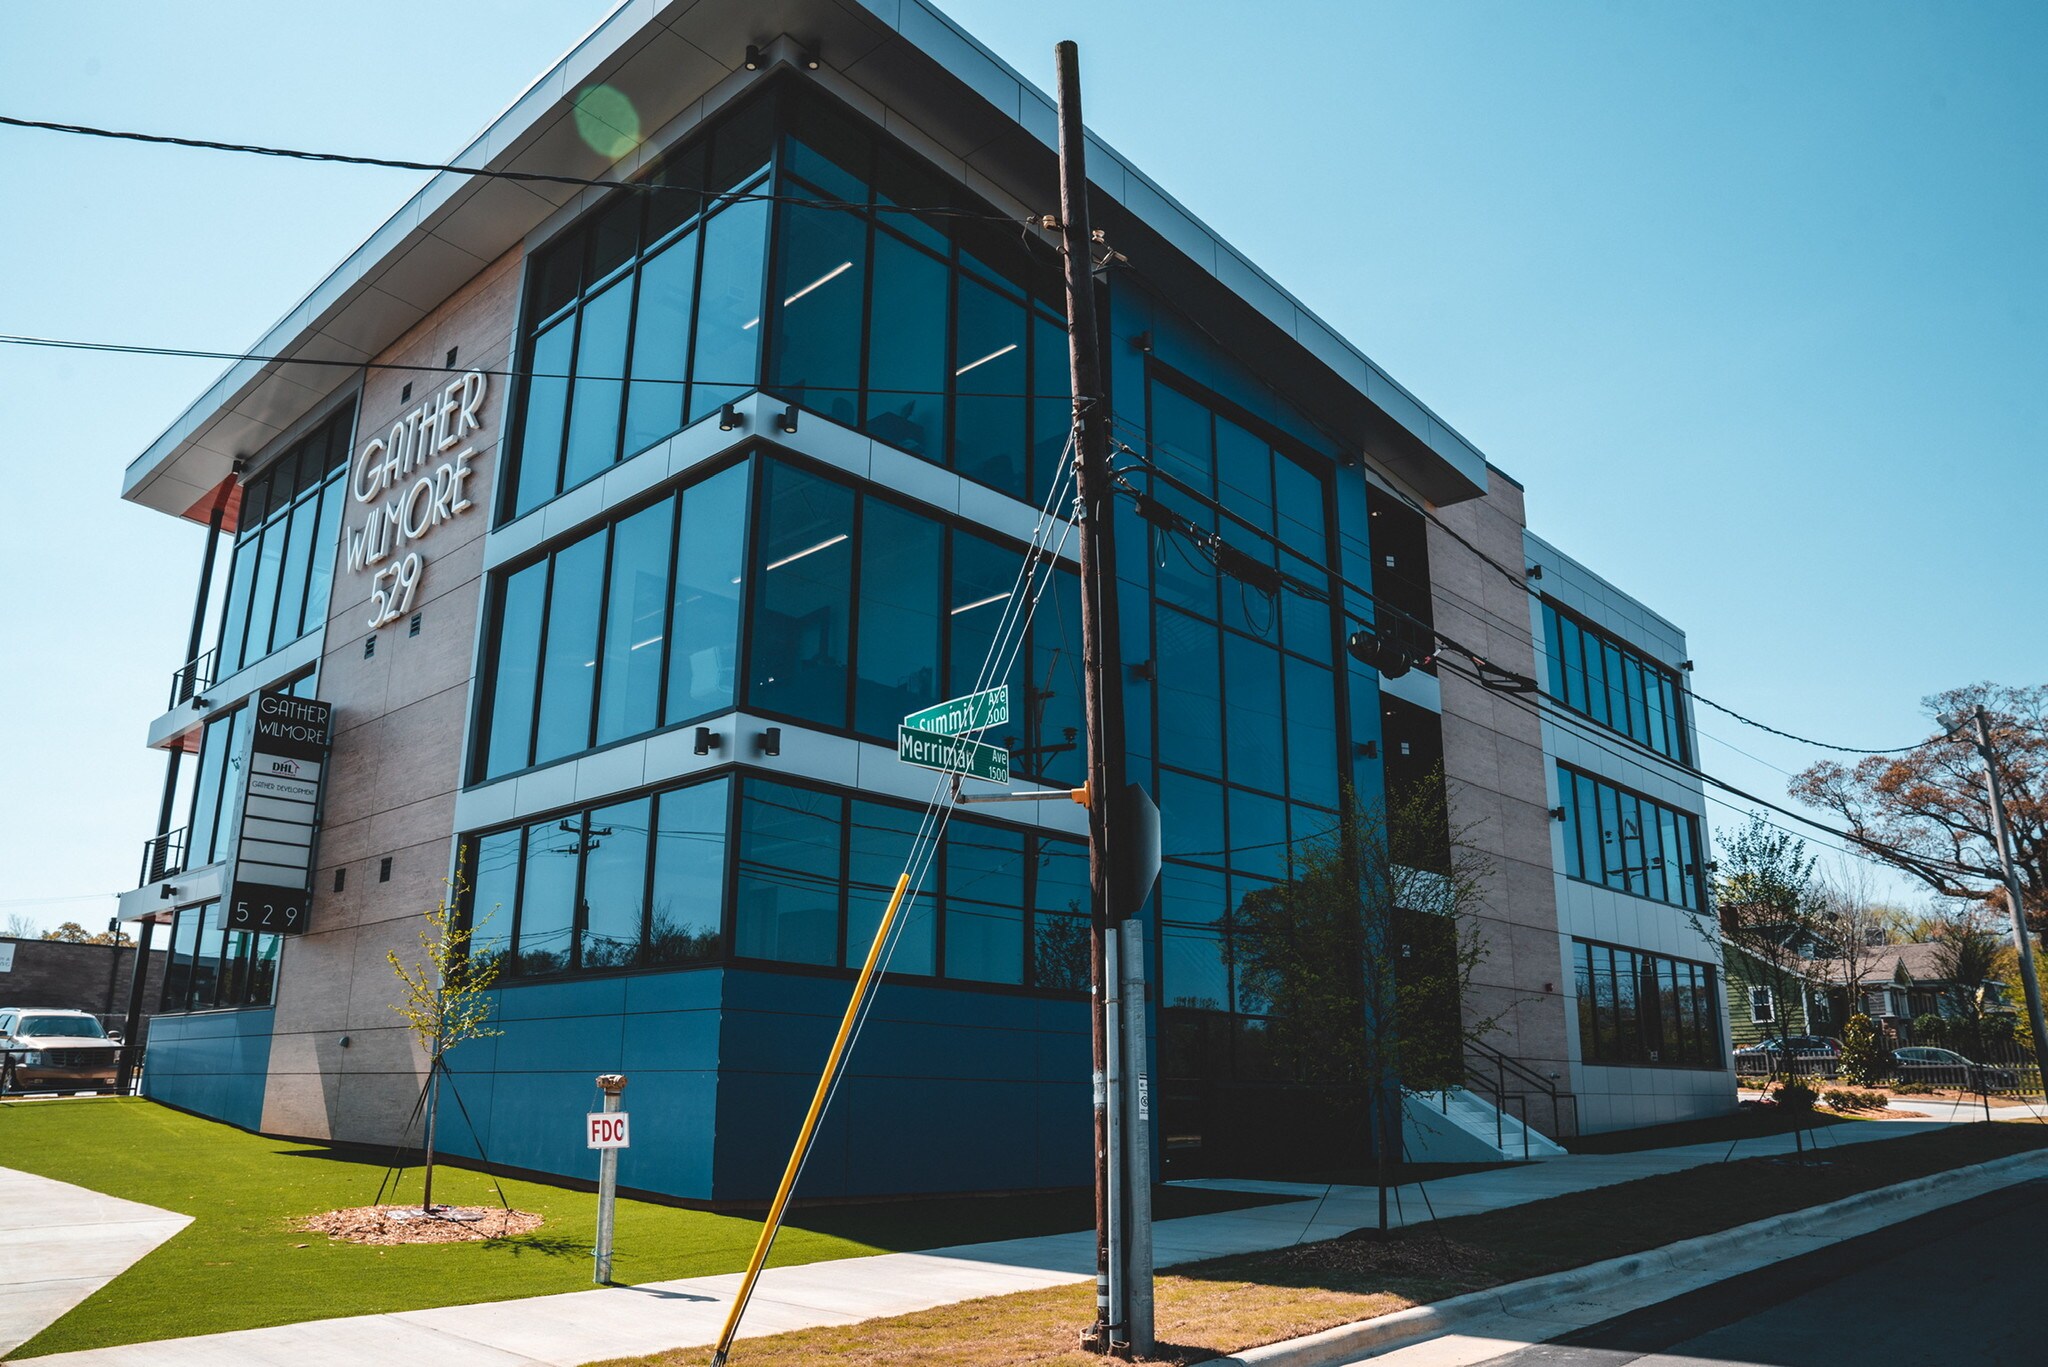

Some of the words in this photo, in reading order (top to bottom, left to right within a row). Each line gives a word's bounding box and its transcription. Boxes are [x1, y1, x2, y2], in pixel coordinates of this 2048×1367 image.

[354, 367, 487, 503] GATHER
[347, 446, 479, 575] WILMORE
[368, 552, 424, 629] 529
[261, 697, 328, 725] GATHER
[988, 690, 1006, 706] Ave
[258, 719, 325, 745] WILMORE
[902, 733, 975, 770] Merriman
[992, 749, 1007, 764] Ave
[272, 761, 294, 774] DHL
[988, 766, 1007, 782] 1500
[251, 780, 275, 790] GATHER
[276, 784, 315, 796] DEVELOPMENT
[591, 1118, 624, 1142] FDC
